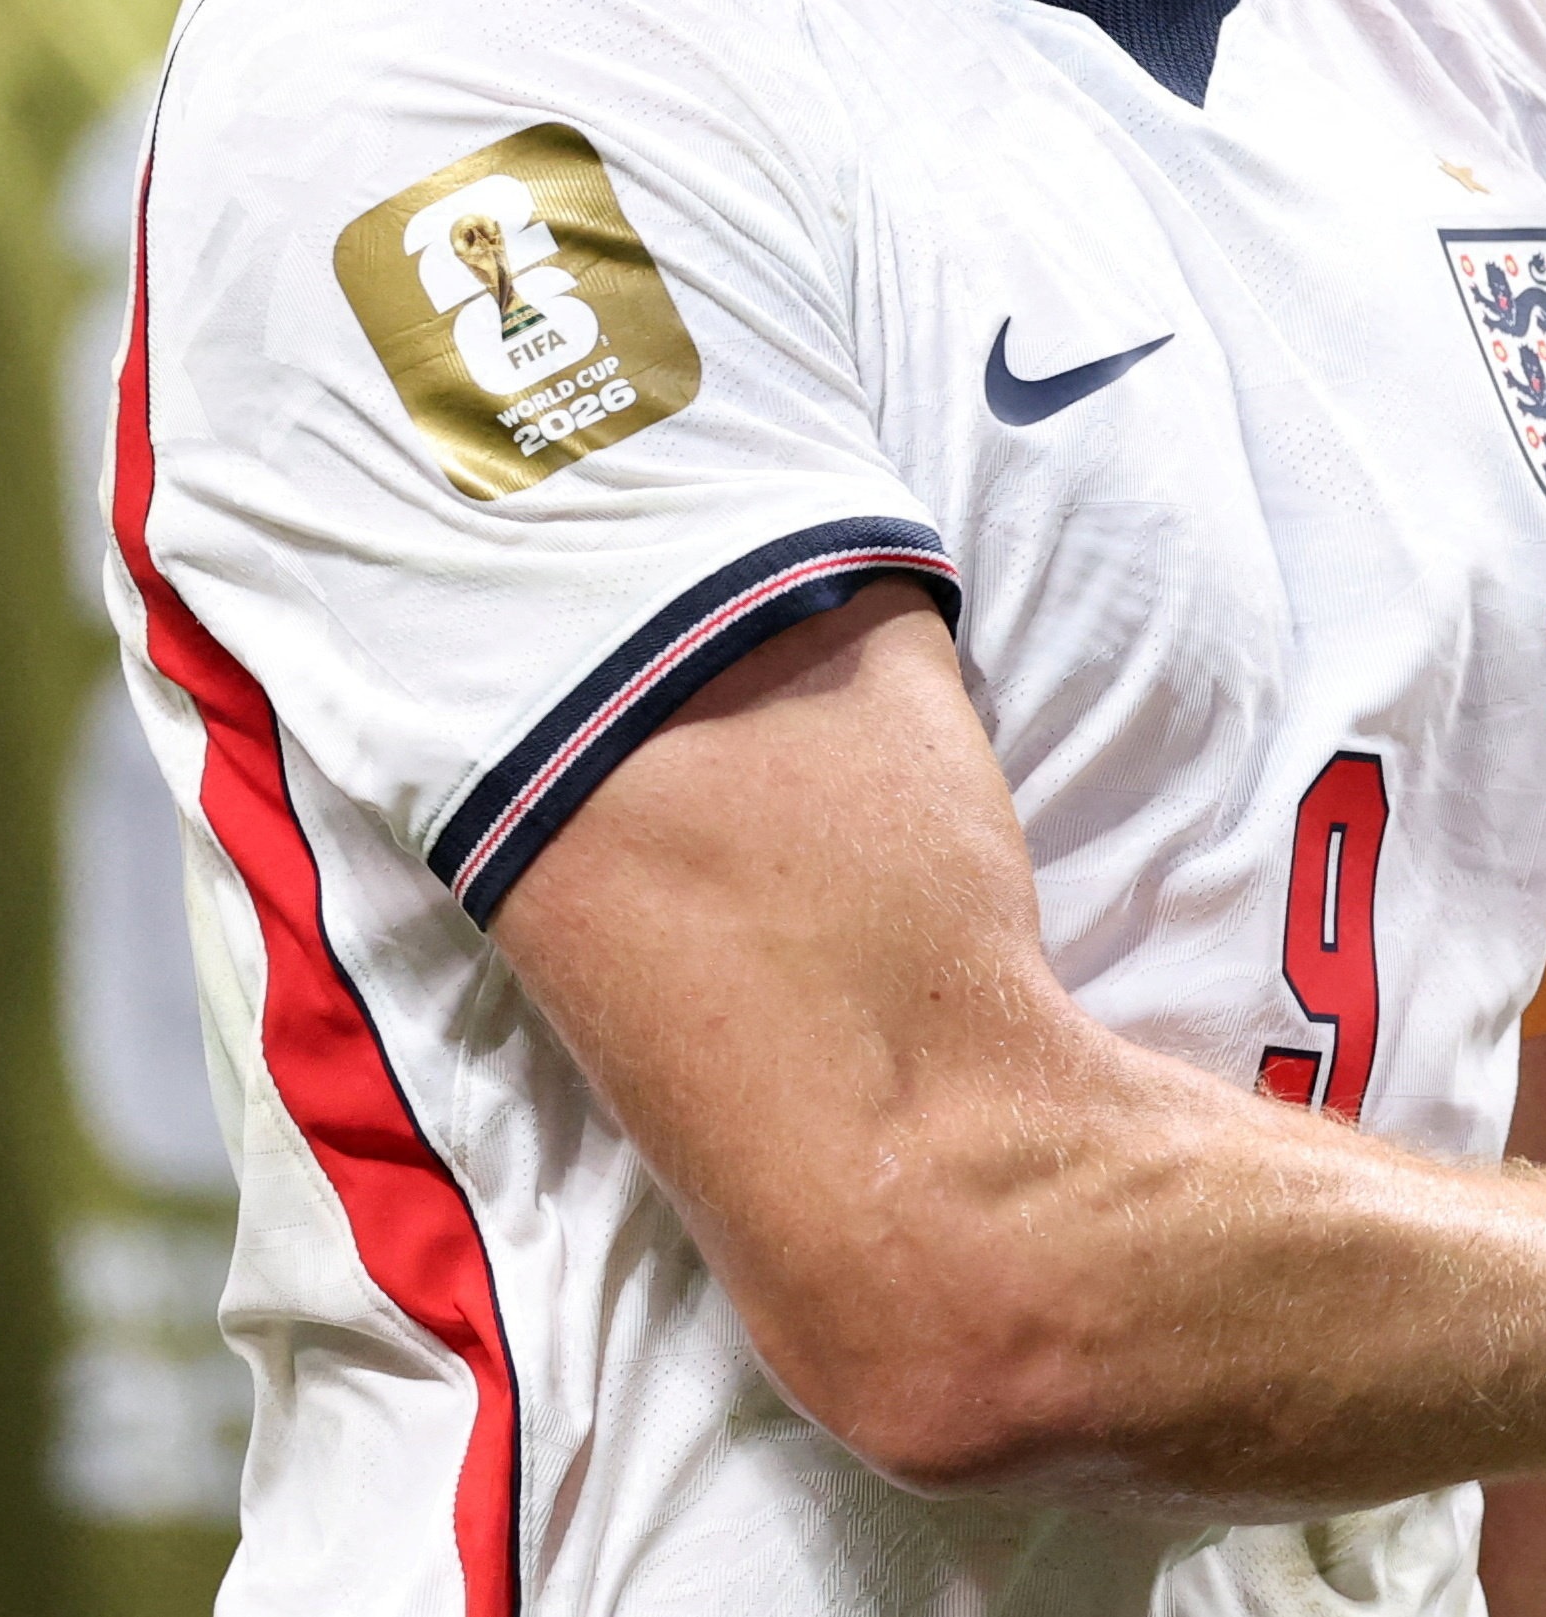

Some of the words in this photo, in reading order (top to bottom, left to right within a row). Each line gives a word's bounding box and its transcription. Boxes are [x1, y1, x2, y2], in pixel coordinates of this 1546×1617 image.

[507, 328, 568, 370] FIFA
[496, 379, 576, 428] WORLD
[576, 355, 620, 388] CUP
[513, 378, 638, 457] 2026
[1260, 750, 1389, 1123] 9
